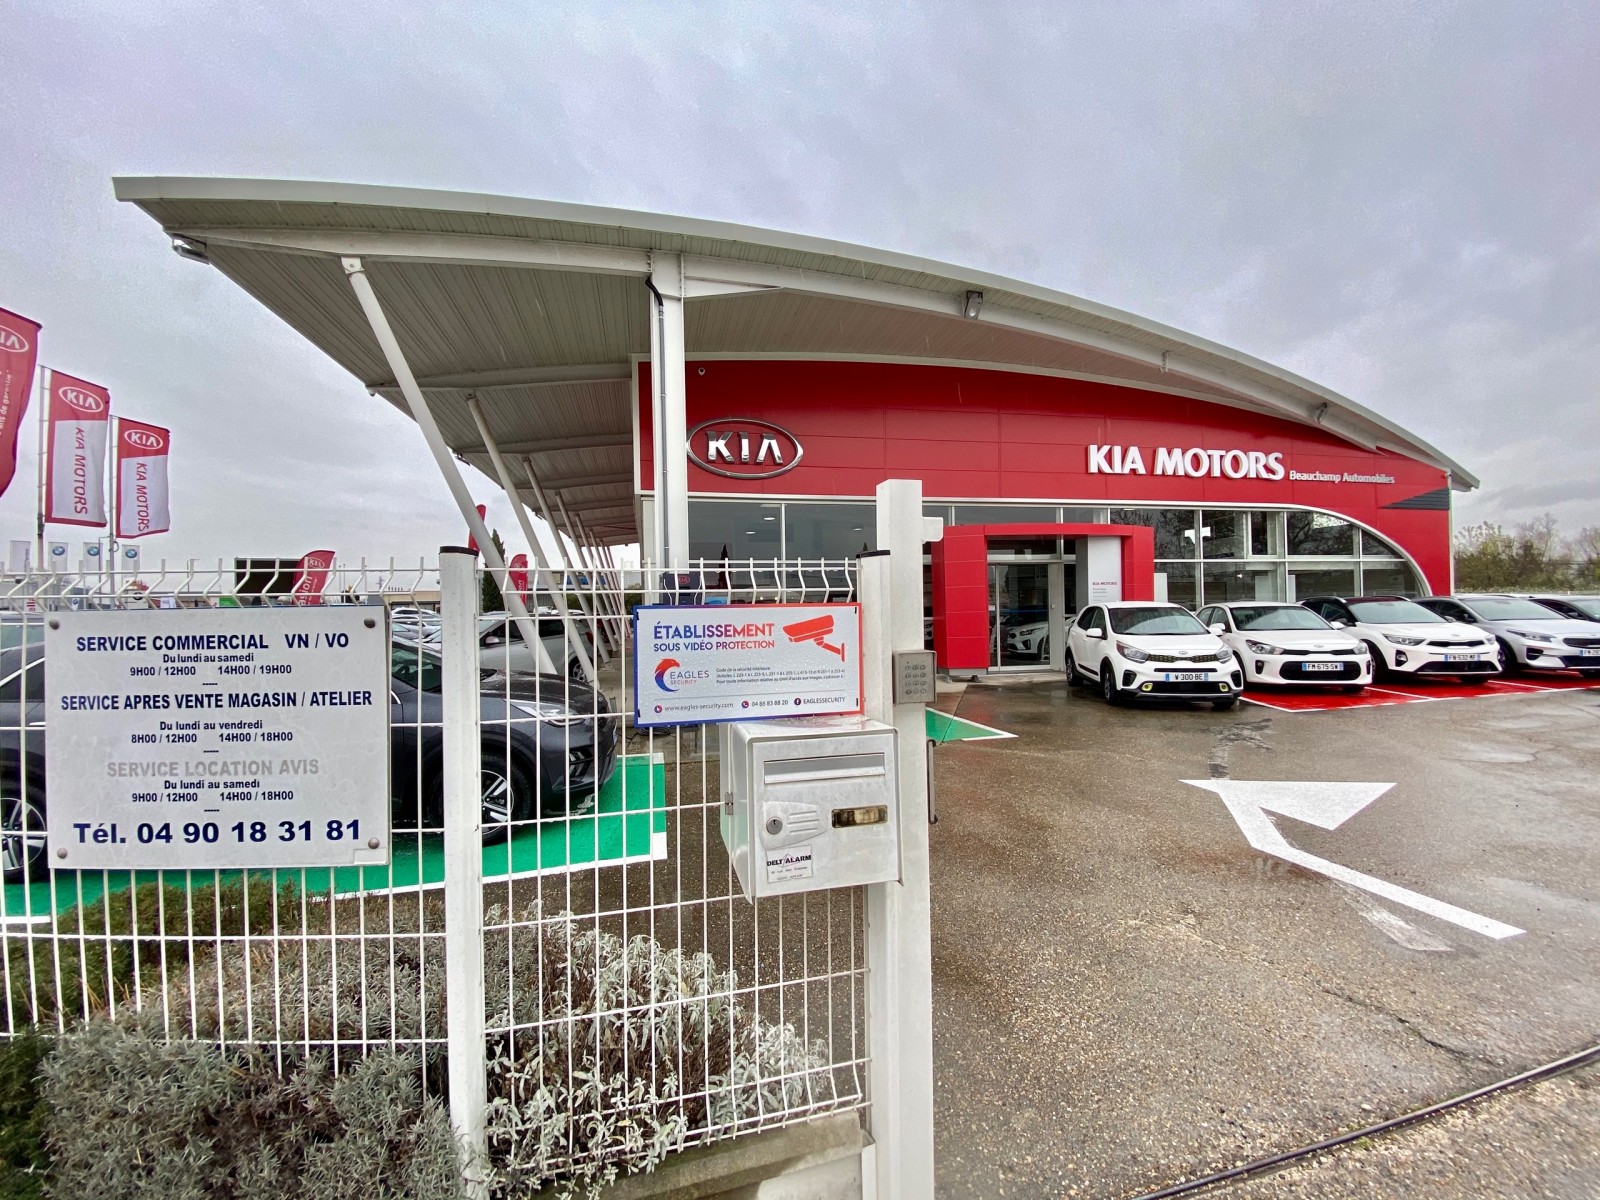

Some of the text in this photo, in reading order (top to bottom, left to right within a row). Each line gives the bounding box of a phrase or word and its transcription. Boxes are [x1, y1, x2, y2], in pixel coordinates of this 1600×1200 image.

[0, 330, 20, 349] IA
[66, 390, 97, 410] KIA
[131, 432, 158, 447] KIA
[706, 431, 783, 463] KIA
[1088, 444, 1284, 481] KIA MOTORS
[73, 427, 88, 514] KIA MOTORS
[1289, 470, 1395, 484] Beauchamp Automobiles
[136, 463, 149, 532] KIA MOTORS
[653, 621, 775, 640] ÉTABLISSEMENT
[77, 636, 147, 651] SERVICE
[152, 635, 269, 651] COMMERCIAL
[285, 634, 309, 648] VN
[325, 633, 349, 648] VO
[653, 639, 775, 652] SOUS VIDÉO PROTECTION
[163, 653, 254, 663] Du lundi au samedi
[130, 667, 155, 676] 9H00
[164, 666, 196, 675] 12H00
[218, 665, 250, 675] 14H00
[259, 665, 292, 674] 19H00
[670, 671, 709, 679] EAGLES
[61, 696, 119, 710] SERVICE
[124, 695, 170, 709] APRES
[175, 694, 223, 709] VENTE
[228, 692, 297, 708] MAGASIN
[310, 691, 373, 706] ATELIER
[665, 702, 734, 712] www.eagles-security.com
[160, 719, 263, 731] Du lundi au vendredi
[131, 734, 157, 743] 8H00
[165, 733, 198, 743] 12H00
[219, 733, 252, 742] 14H00
[260, 732, 293, 741] 18H00
[107, 759, 320, 778] SERVICE LOCATION AVIS
[164, 778, 260, 789] Du lundi au samedi
[132, 793, 158, 802] 9H00
[166, 792, 198, 802] 12H00
[220, 792, 252, 801] 14H00
[261, 791, 294, 800] 18H00
[73, 819, 359, 844] Tél. 04 90 18 31 81
